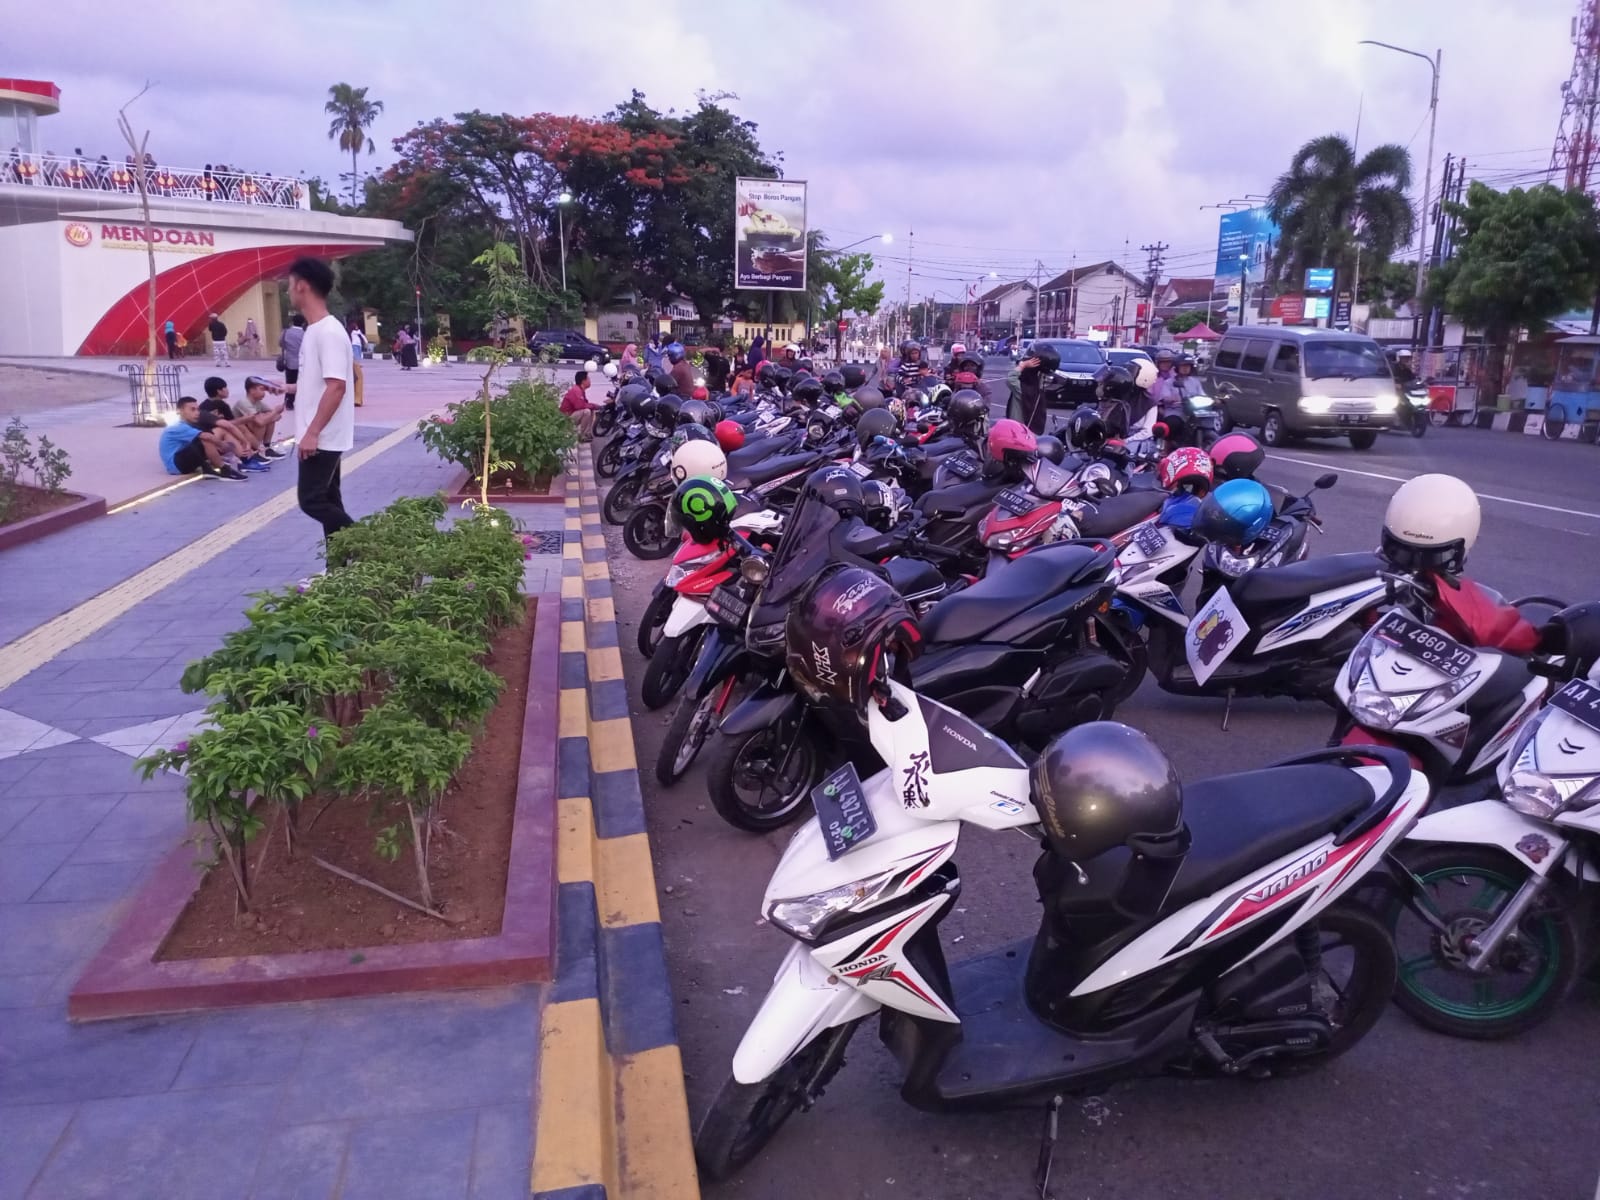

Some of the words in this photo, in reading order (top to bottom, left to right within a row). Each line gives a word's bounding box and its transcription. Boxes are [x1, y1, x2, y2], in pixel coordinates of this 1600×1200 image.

[101, 224, 215, 246] MENDOAN
[1386, 619, 1408, 635] AA
[1407, 628, 1447, 652] 4860
[1450, 648, 1471, 666] YD
[1563, 684, 1590, 701] AA
[942, 724, 978, 752] HONDA
[831, 771, 850, 793] AA
[837, 954, 889, 974] HONDA
